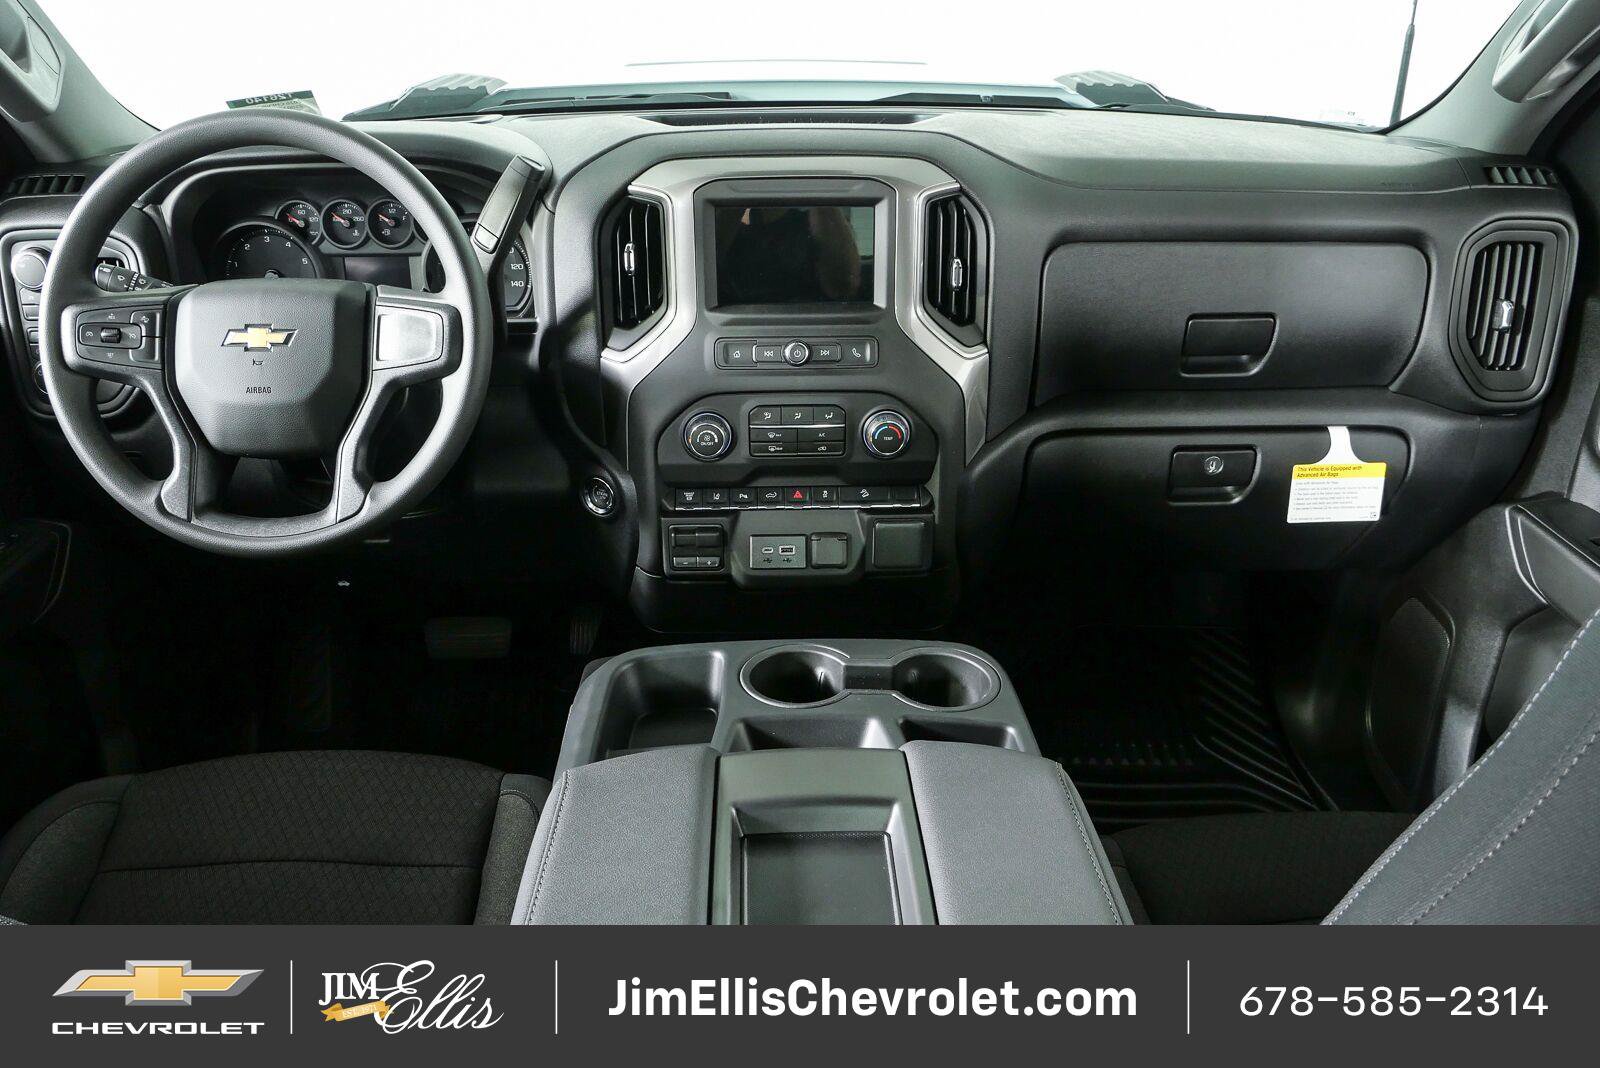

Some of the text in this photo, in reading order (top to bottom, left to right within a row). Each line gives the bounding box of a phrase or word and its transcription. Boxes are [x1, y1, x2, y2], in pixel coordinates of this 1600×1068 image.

[244, 243, 251, 251] 2
[302, 257, 308, 265] 5
[245, 386, 273, 394] AIRBAG
